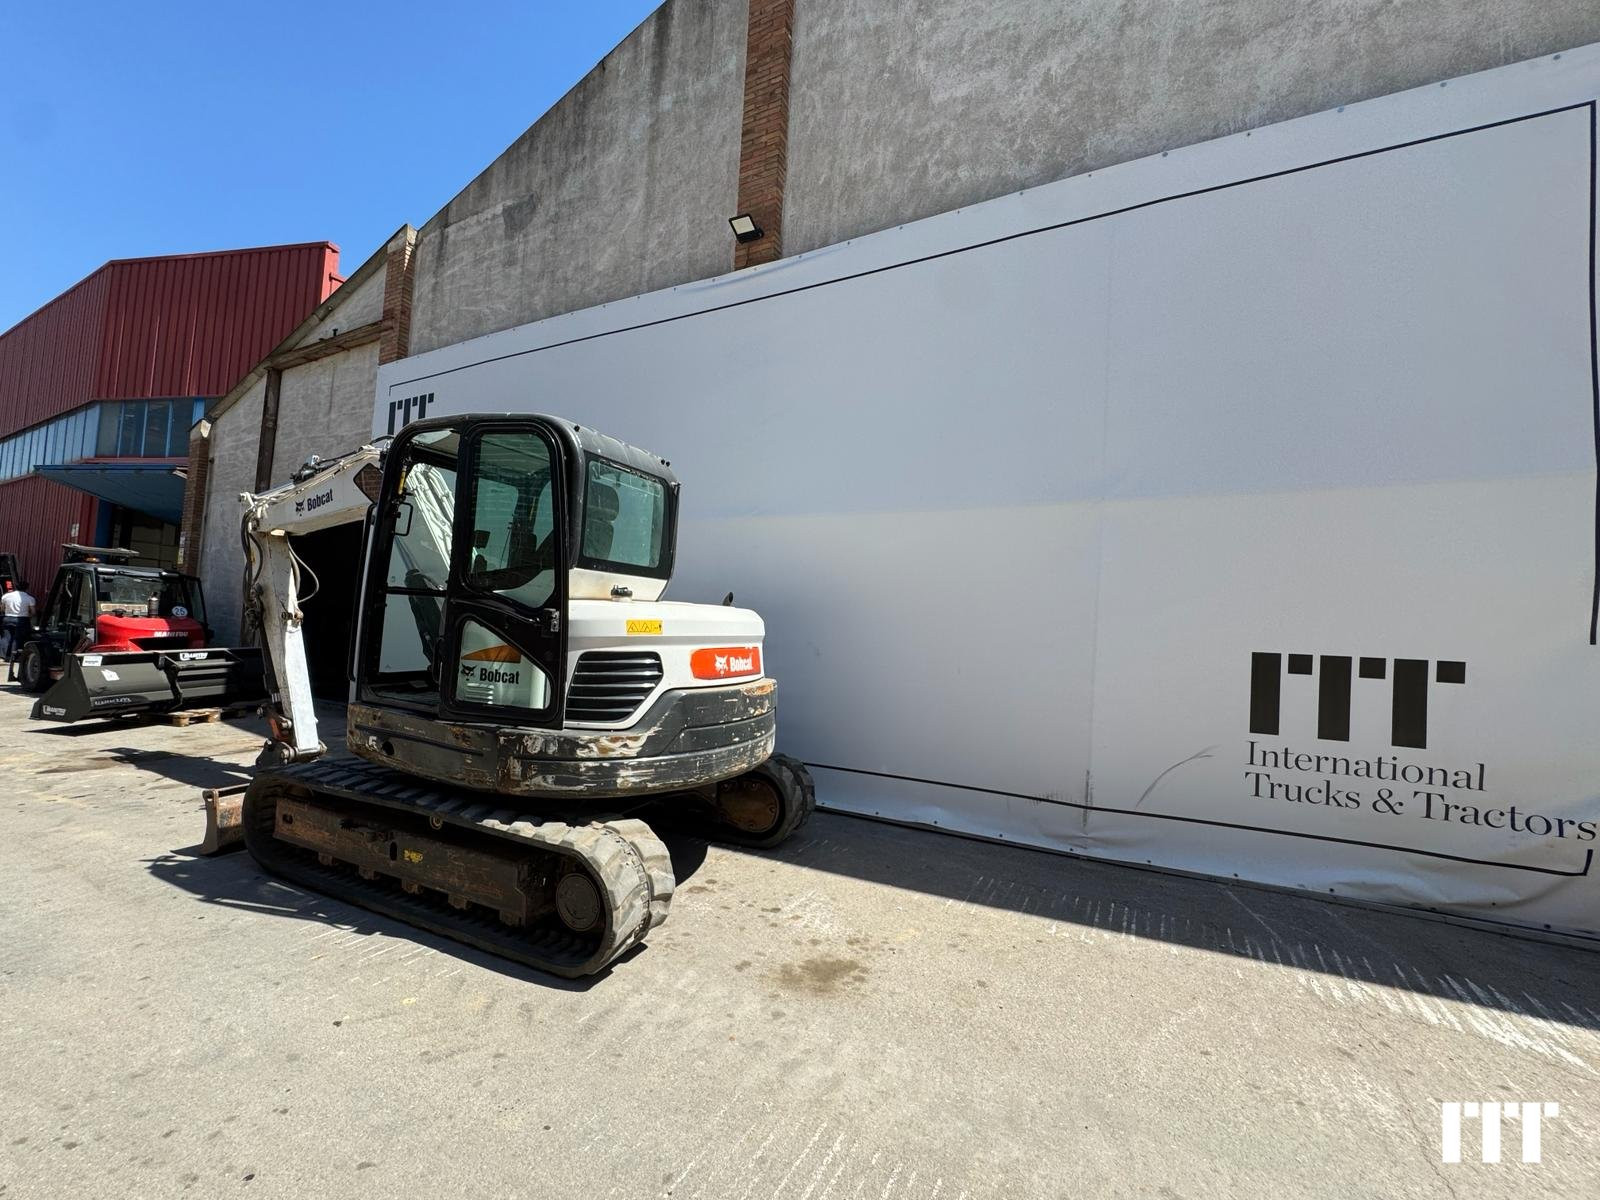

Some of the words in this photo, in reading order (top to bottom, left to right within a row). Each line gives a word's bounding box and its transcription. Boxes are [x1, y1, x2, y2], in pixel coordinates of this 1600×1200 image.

[307, 488, 333, 512] Bobcat
[729, 654, 753, 672] Bobcat
[480, 668, 520, 684] Bobcat
[1245, 741, 1487, 792] International
[1245, 771, 1361, 810] Trucks
[1372, 787, 1404, 816] &
[1413, 791, 1598, 842] Tractors
